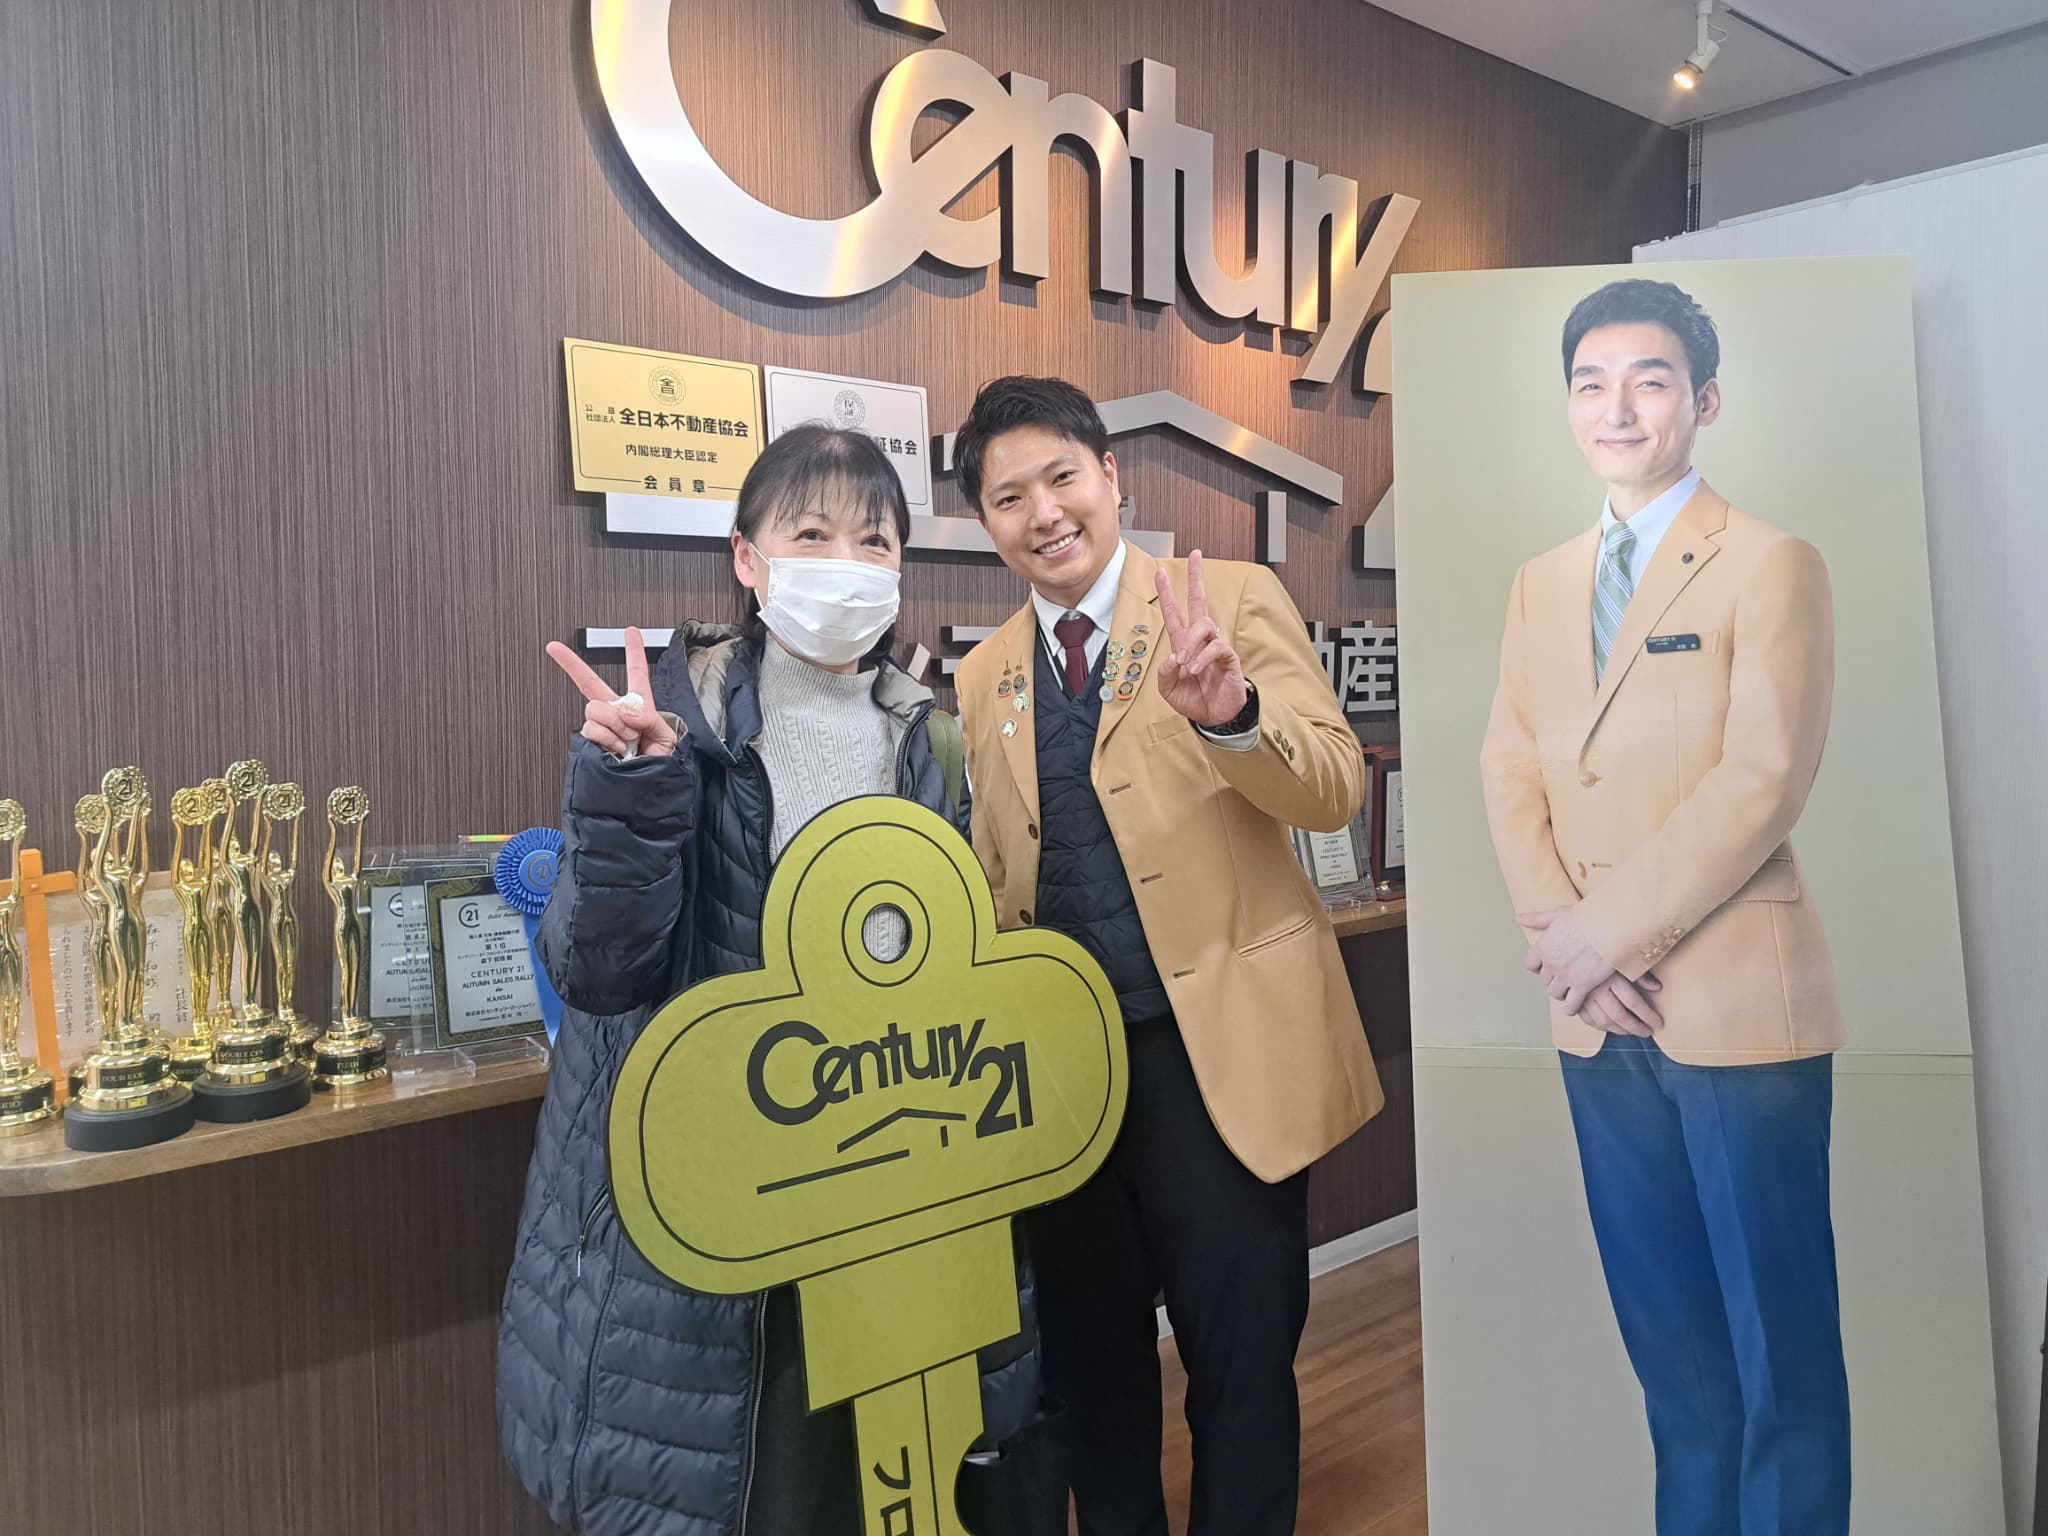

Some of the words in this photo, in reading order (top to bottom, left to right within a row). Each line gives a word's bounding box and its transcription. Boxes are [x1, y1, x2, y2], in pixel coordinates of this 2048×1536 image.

[590, 0, 1421, 384] Century
[619, 407, 749, 438] 全日本不動産協会
[625, 443, 718, 464] 内閣総理大臣認定
[643, 475, 706, 494] 会員章
[471, 966, 514, 979] CENTURY
[486, 993, 513, 1003] KANSAI
[747, 1018, 985, 1126] Century
[968, 1041, 1034, 1139] 21
